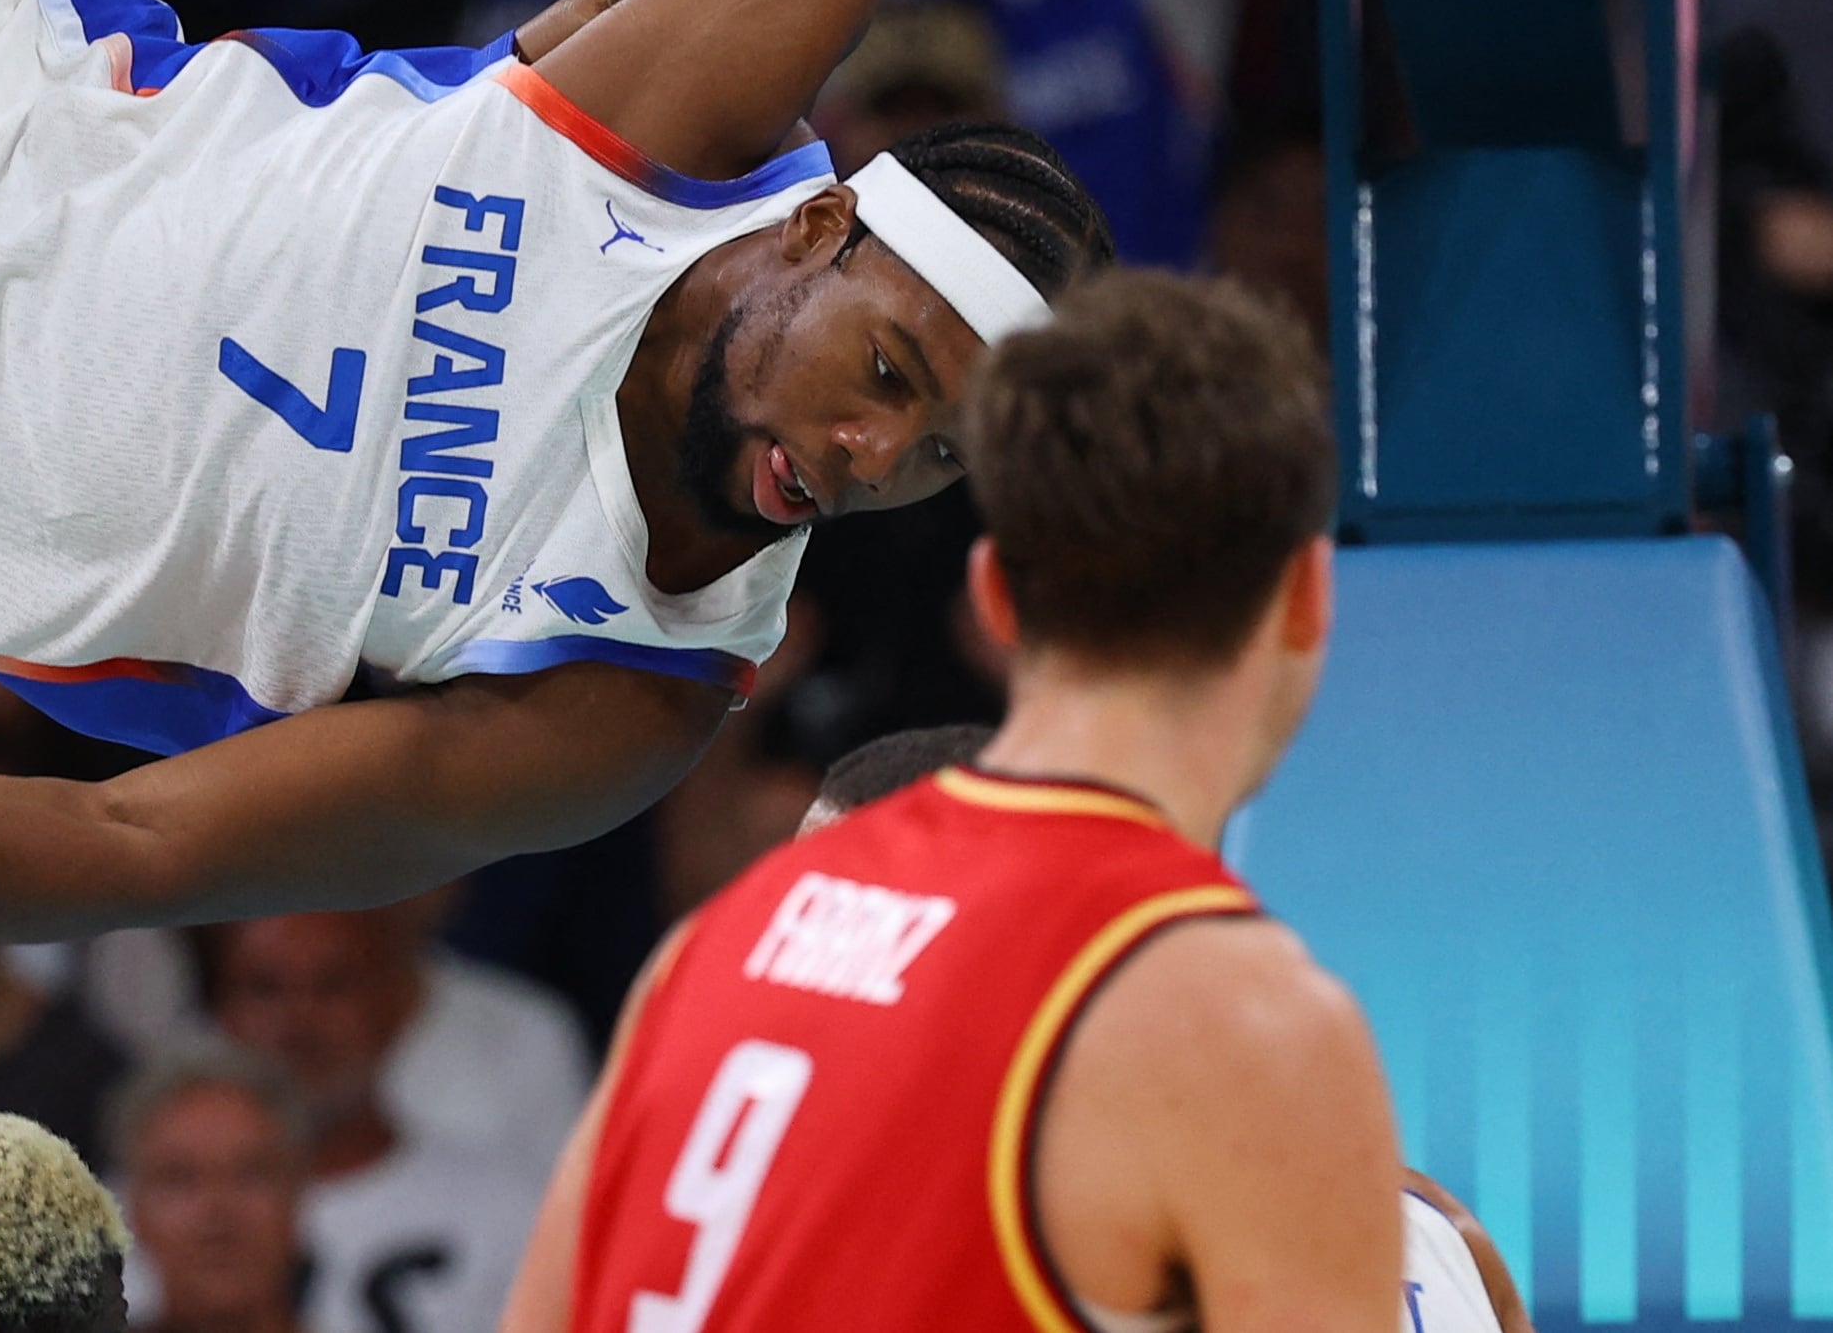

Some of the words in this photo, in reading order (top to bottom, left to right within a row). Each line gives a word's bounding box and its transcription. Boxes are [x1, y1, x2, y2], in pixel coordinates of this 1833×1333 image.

[219, 337, 367, 453] 7
[380, 185, 525, 605] FRANCE
[744, 871, 957, 1005] FRANZ
[625, 1038, 816, 1333] 9
